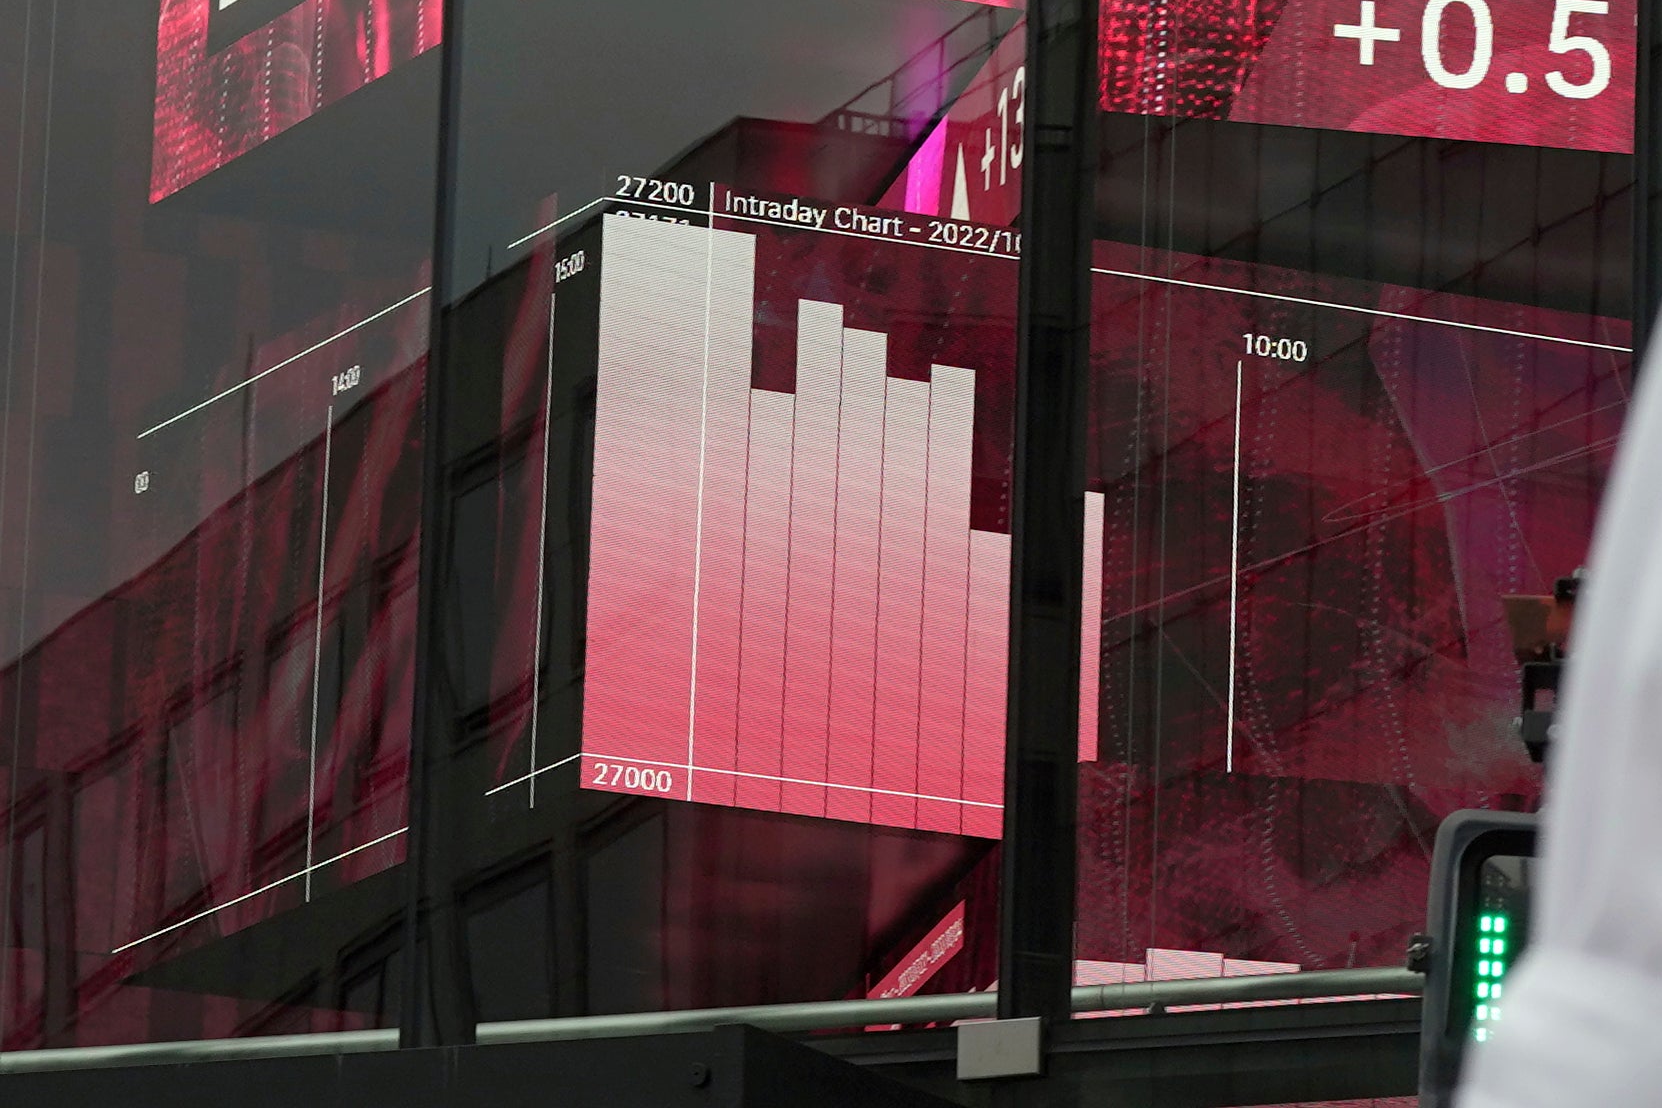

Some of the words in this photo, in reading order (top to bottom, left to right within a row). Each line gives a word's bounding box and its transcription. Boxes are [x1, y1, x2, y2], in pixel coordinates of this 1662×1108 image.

[615, 175, 695, 206] 27200
[725, 190, 827, 230] Intraday
[834, 207, 904, 237] Chart
[1242, 334, 1308, 362] 10:00
[592, 763, 673, 793] 27000
